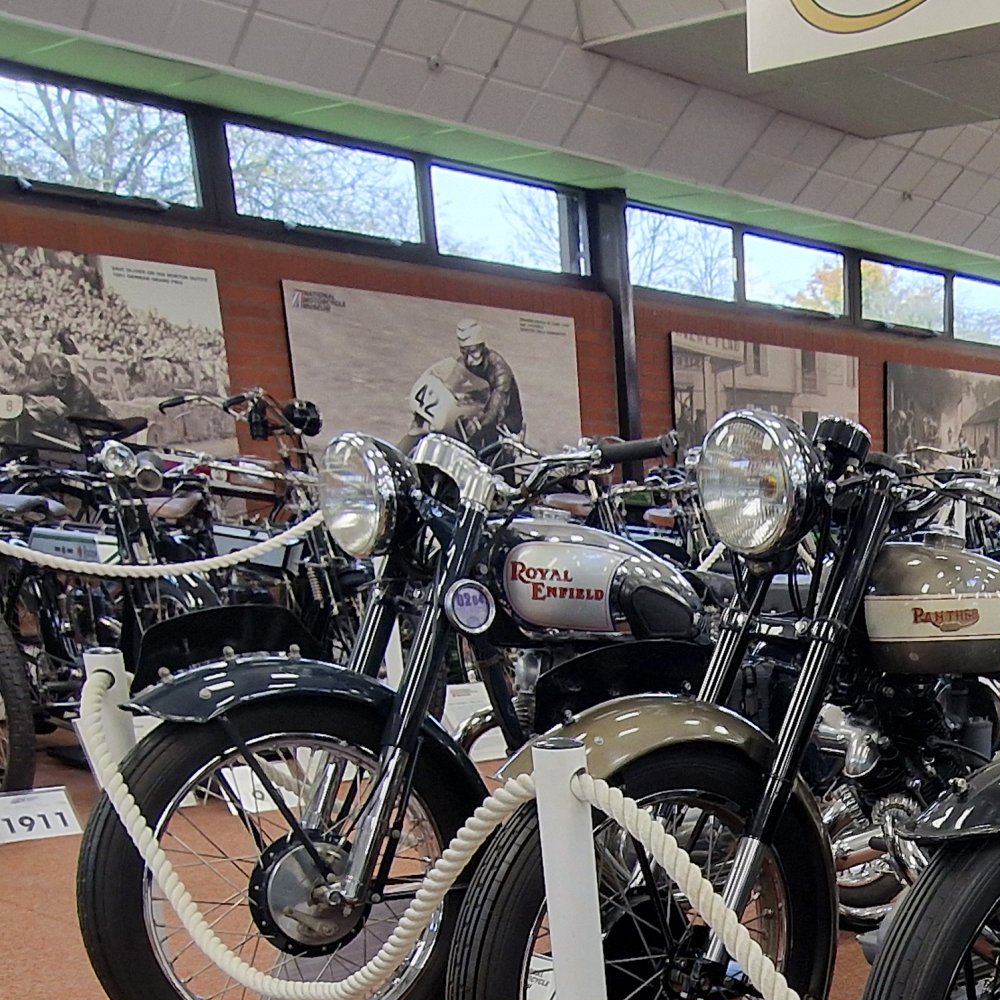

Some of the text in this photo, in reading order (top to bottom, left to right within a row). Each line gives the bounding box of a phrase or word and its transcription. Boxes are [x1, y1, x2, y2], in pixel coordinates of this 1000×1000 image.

[415, 384, 439, 418] 42
[511, 561, 573, 584] ROYAL
[532, 582, 605, 601] ENFIELD
[1, 811, 69, 834] 1911
